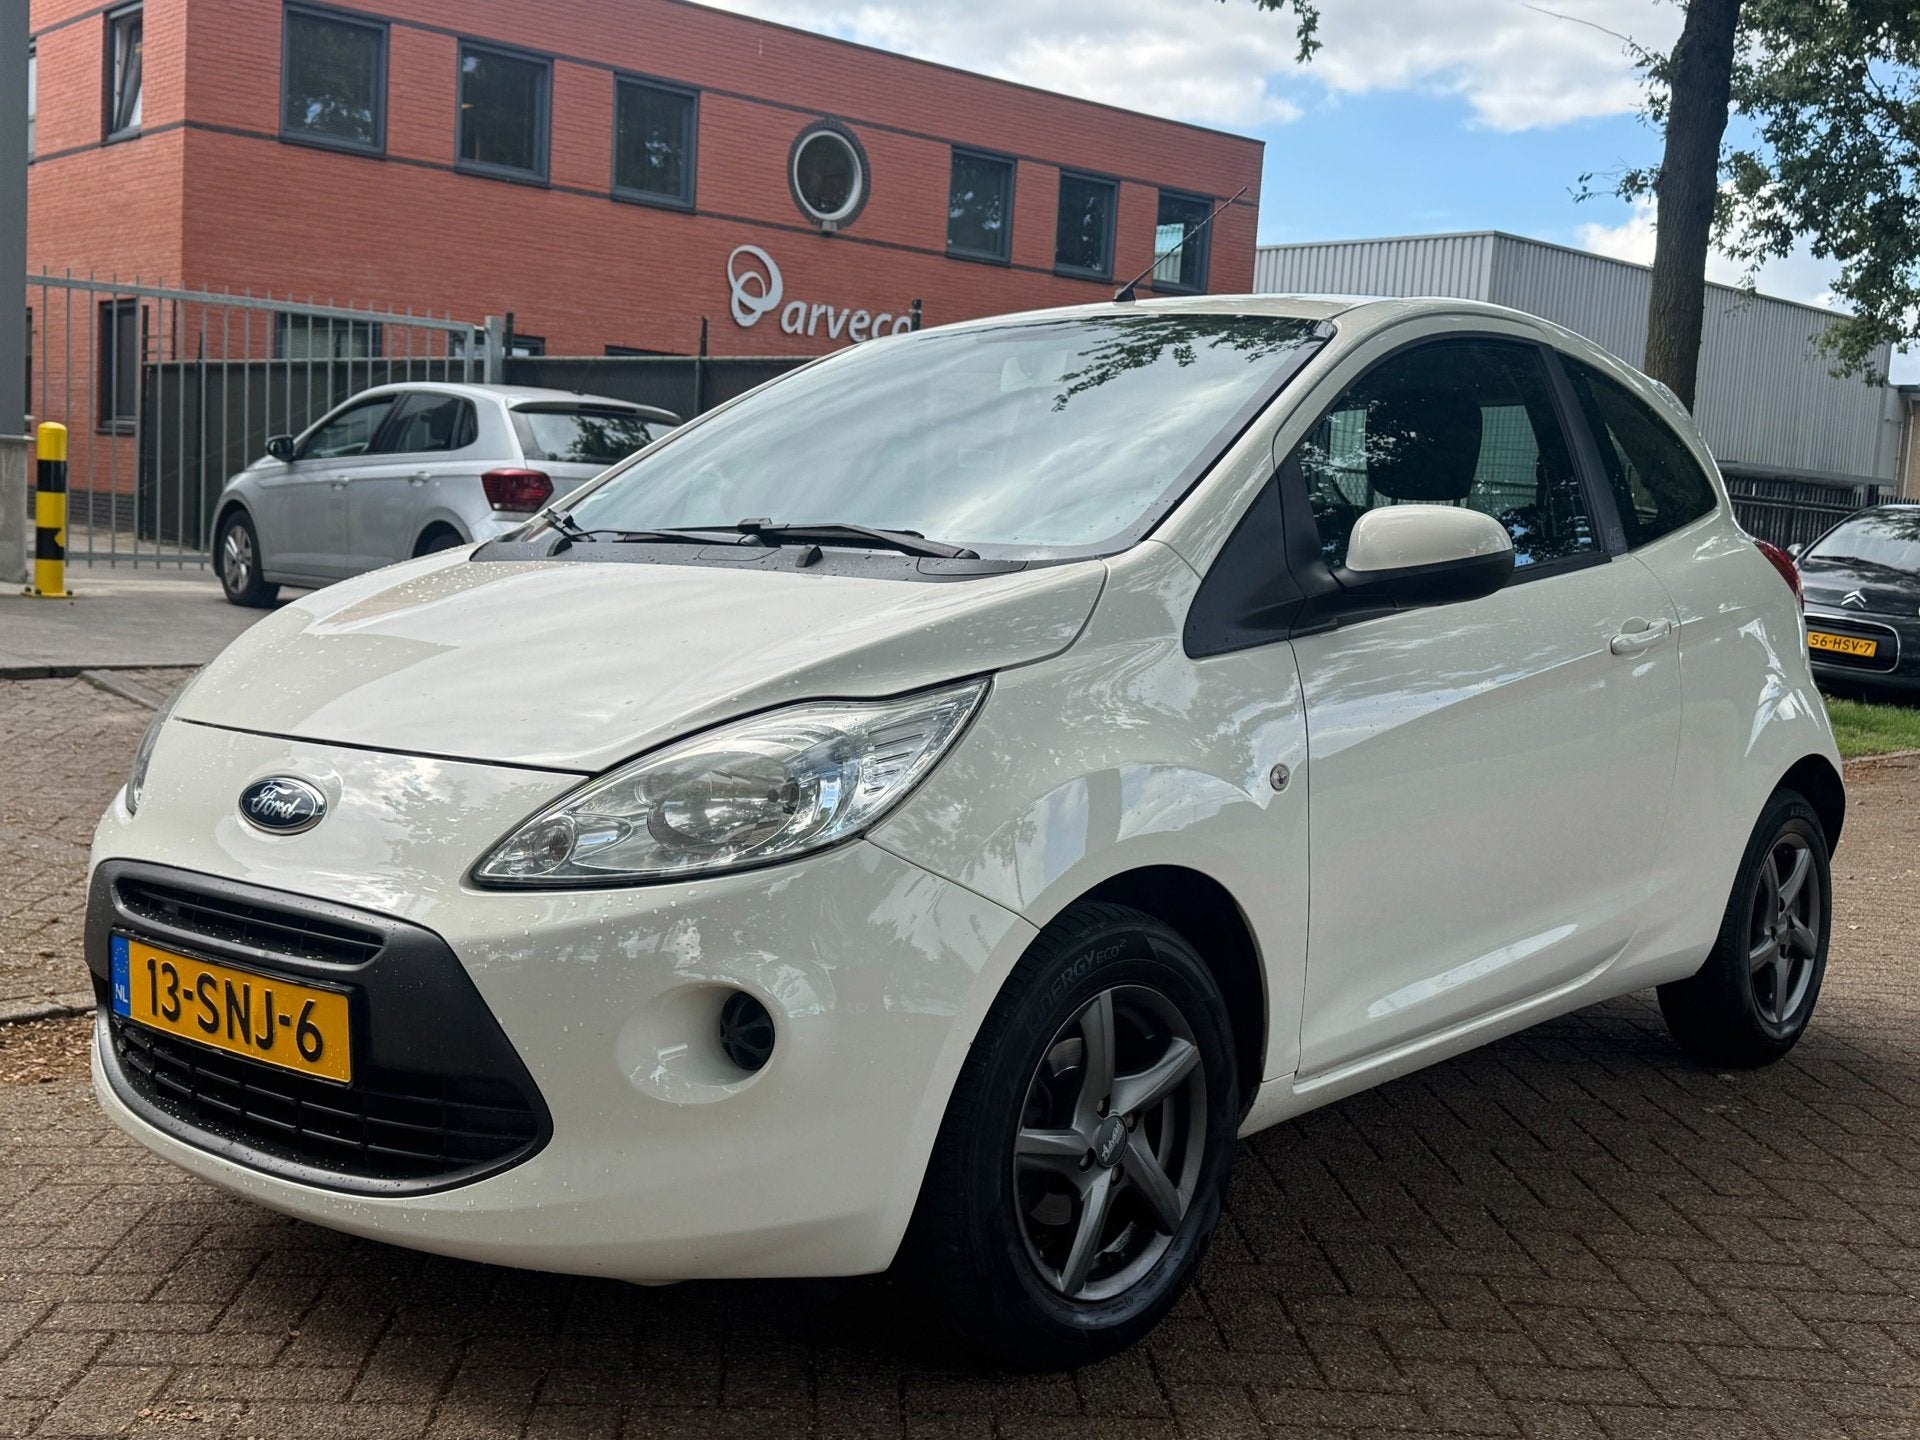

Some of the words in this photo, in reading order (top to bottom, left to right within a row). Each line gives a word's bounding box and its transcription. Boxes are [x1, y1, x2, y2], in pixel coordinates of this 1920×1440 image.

[1811, 634, 1872, 654] 56-HSV-7
[250, 784, 302, 820] Ford
[115, 982, 129, 1003] NL
[147, 957, 323, 1063] 13-SNJ-6
